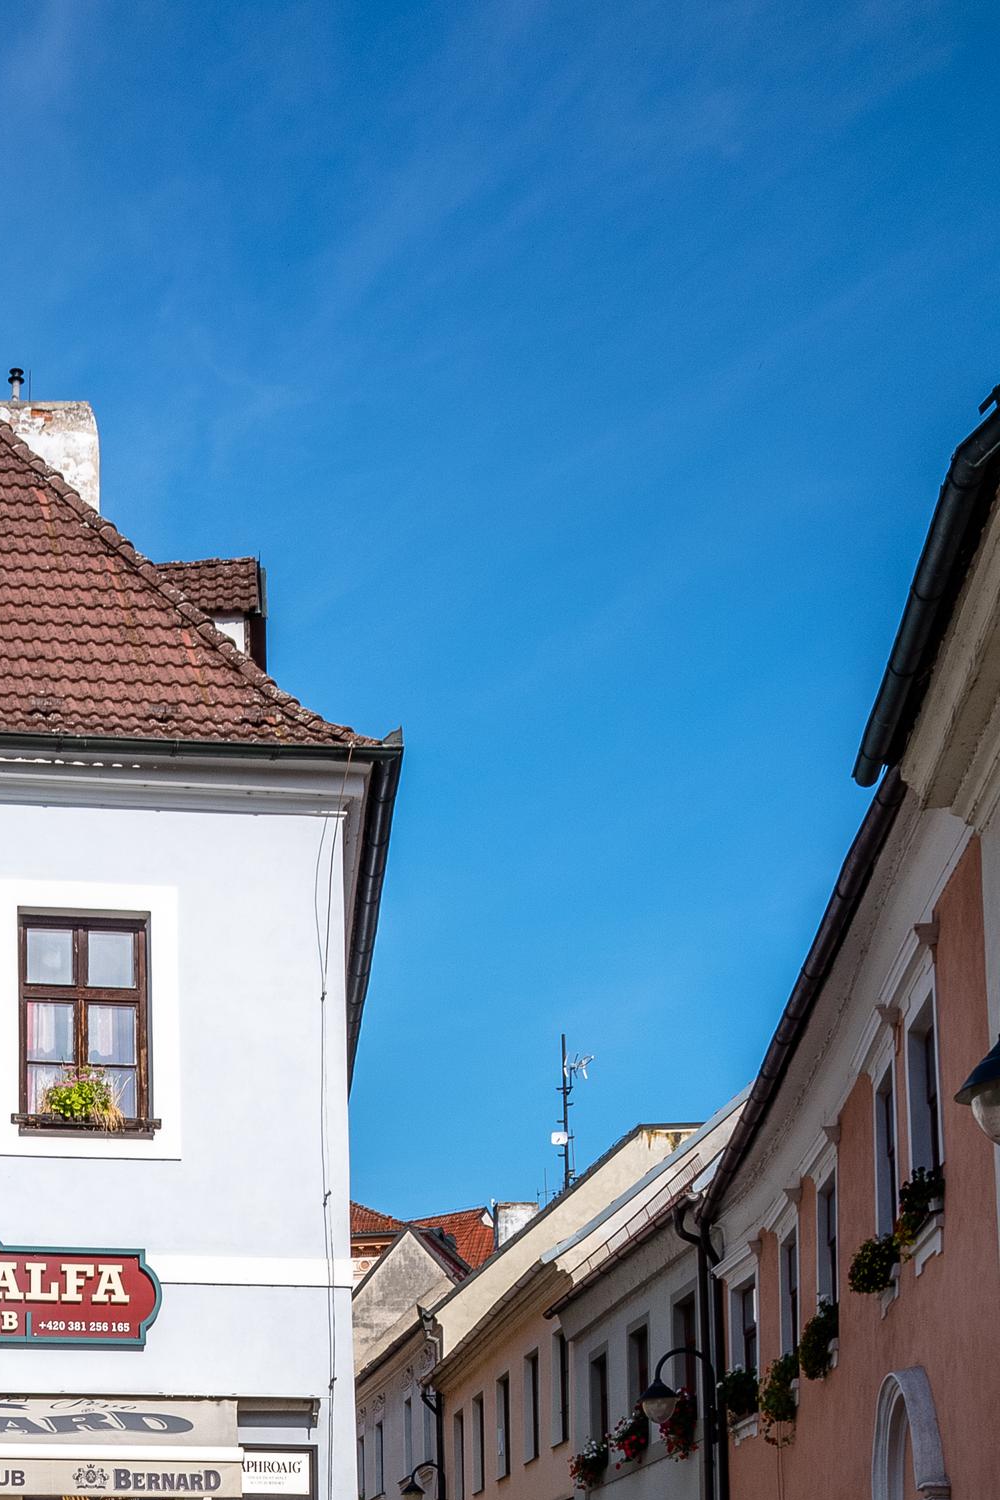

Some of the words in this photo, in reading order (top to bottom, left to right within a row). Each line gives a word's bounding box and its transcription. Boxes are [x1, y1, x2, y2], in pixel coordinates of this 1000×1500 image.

[39, 1321, 65, 1331] +420
[68, 1321, 87, 1332] 381
[89, 1322, 109, 1332] 256
[112, 1322, 130, 1333] 165
[113, 1468, 221, 1492] BERNARD
